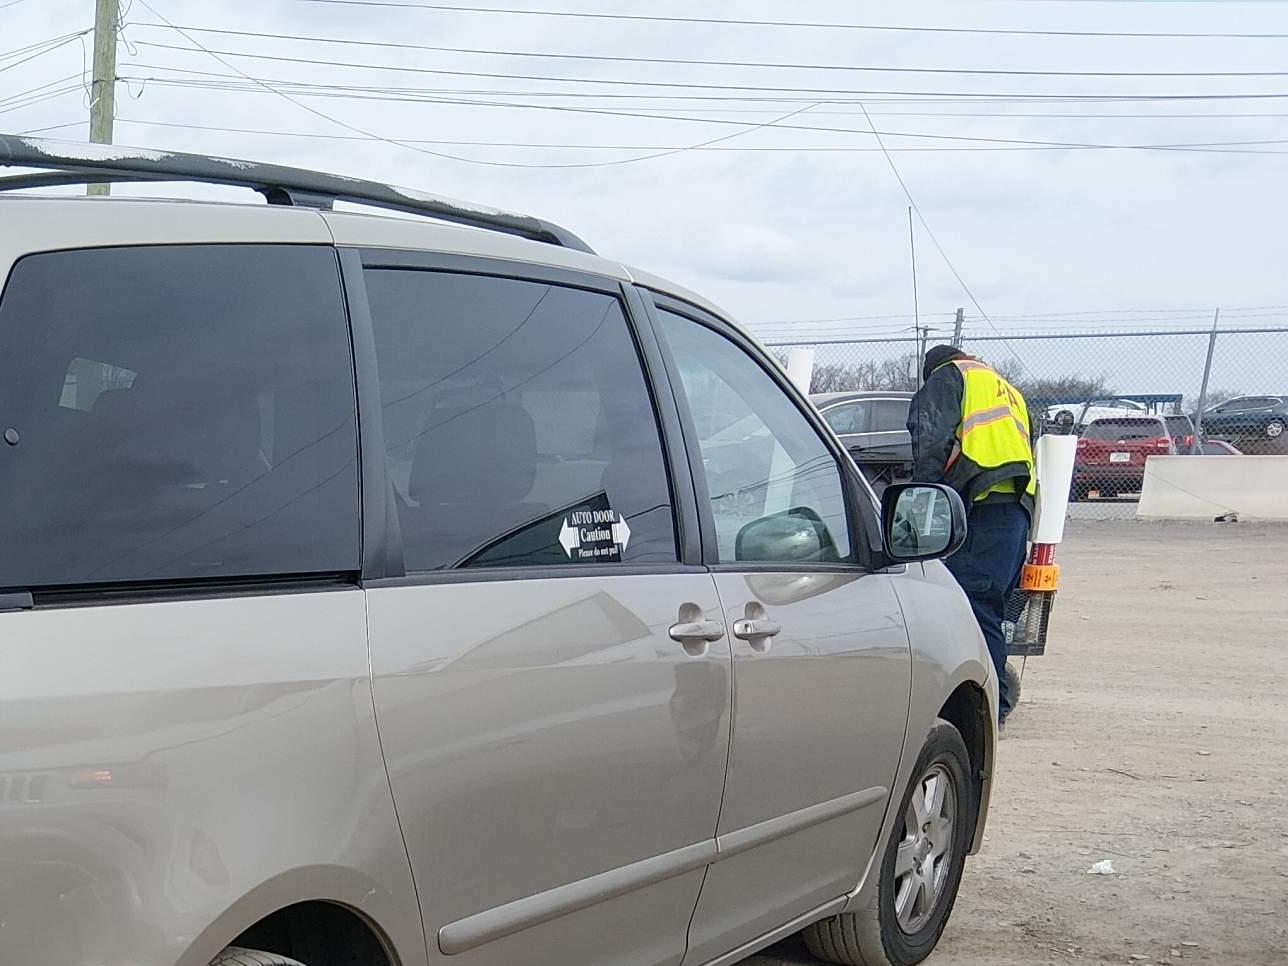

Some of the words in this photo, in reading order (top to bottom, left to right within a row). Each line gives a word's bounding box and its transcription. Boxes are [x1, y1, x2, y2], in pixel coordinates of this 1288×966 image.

[571, 511, 592, 525] AUTO
[593, 509, 615, 523] DOOR
[580, 526, 611, 542] Caution
[578, 548, 593, 559] Please
